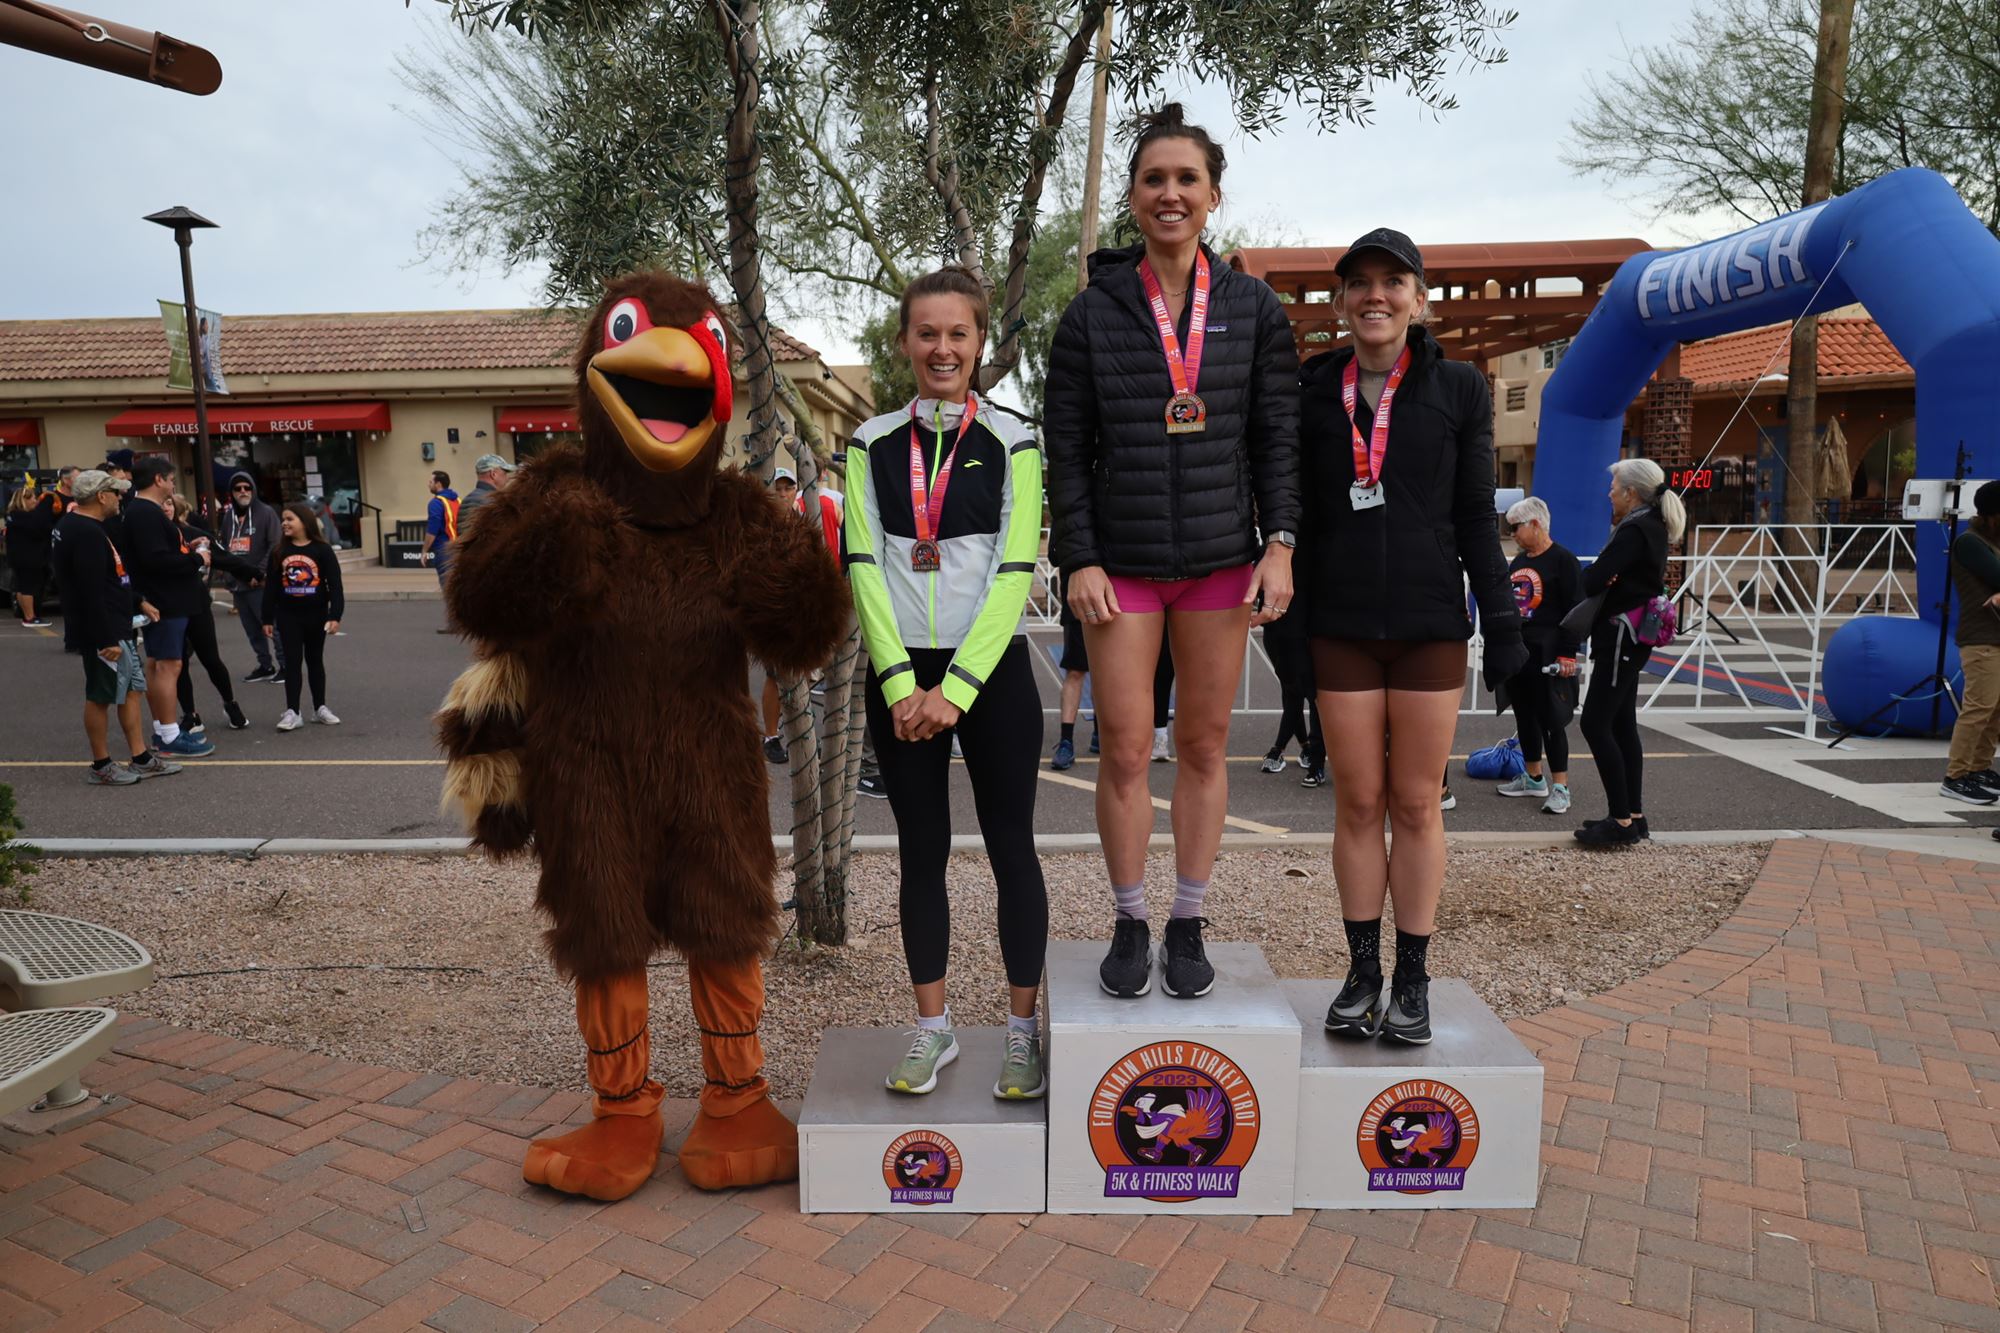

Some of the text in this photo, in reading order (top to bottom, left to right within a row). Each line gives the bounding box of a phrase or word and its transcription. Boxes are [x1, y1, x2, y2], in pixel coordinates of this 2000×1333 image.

[1637, 219, 1810, 319] FINISH
[1194, 288, 1208, 306] TROT
[1151, 294, 1174, 337] TURKEY TROT
[1190, 307, 1205, 334] TURKEY
[1376, 402, 1390, 428] TURKEY
[153, 420, 314, 434] FEARLES KITTY RESCUE
[912, 447, 925, 491] TURKEY TROT
[1092, 1045, 1256, 1128] FOUNTAIN HILLS TURKEY TROT
[1153, 1074, 1197, 1086] 2023
[1360, 1082, 1477, 1141] FOUNTAIN HILLS TURKEY TROT
[1404, 1103, 1436, 1112] 2023
[1111, 1172, 1234, 1191] 5K & FITNESS WALK
[1373, 1172, 1461, 1186] 5K & FITNESS WALK
[893, 1190, 951, 1200] 5K & FITNESS WALK
